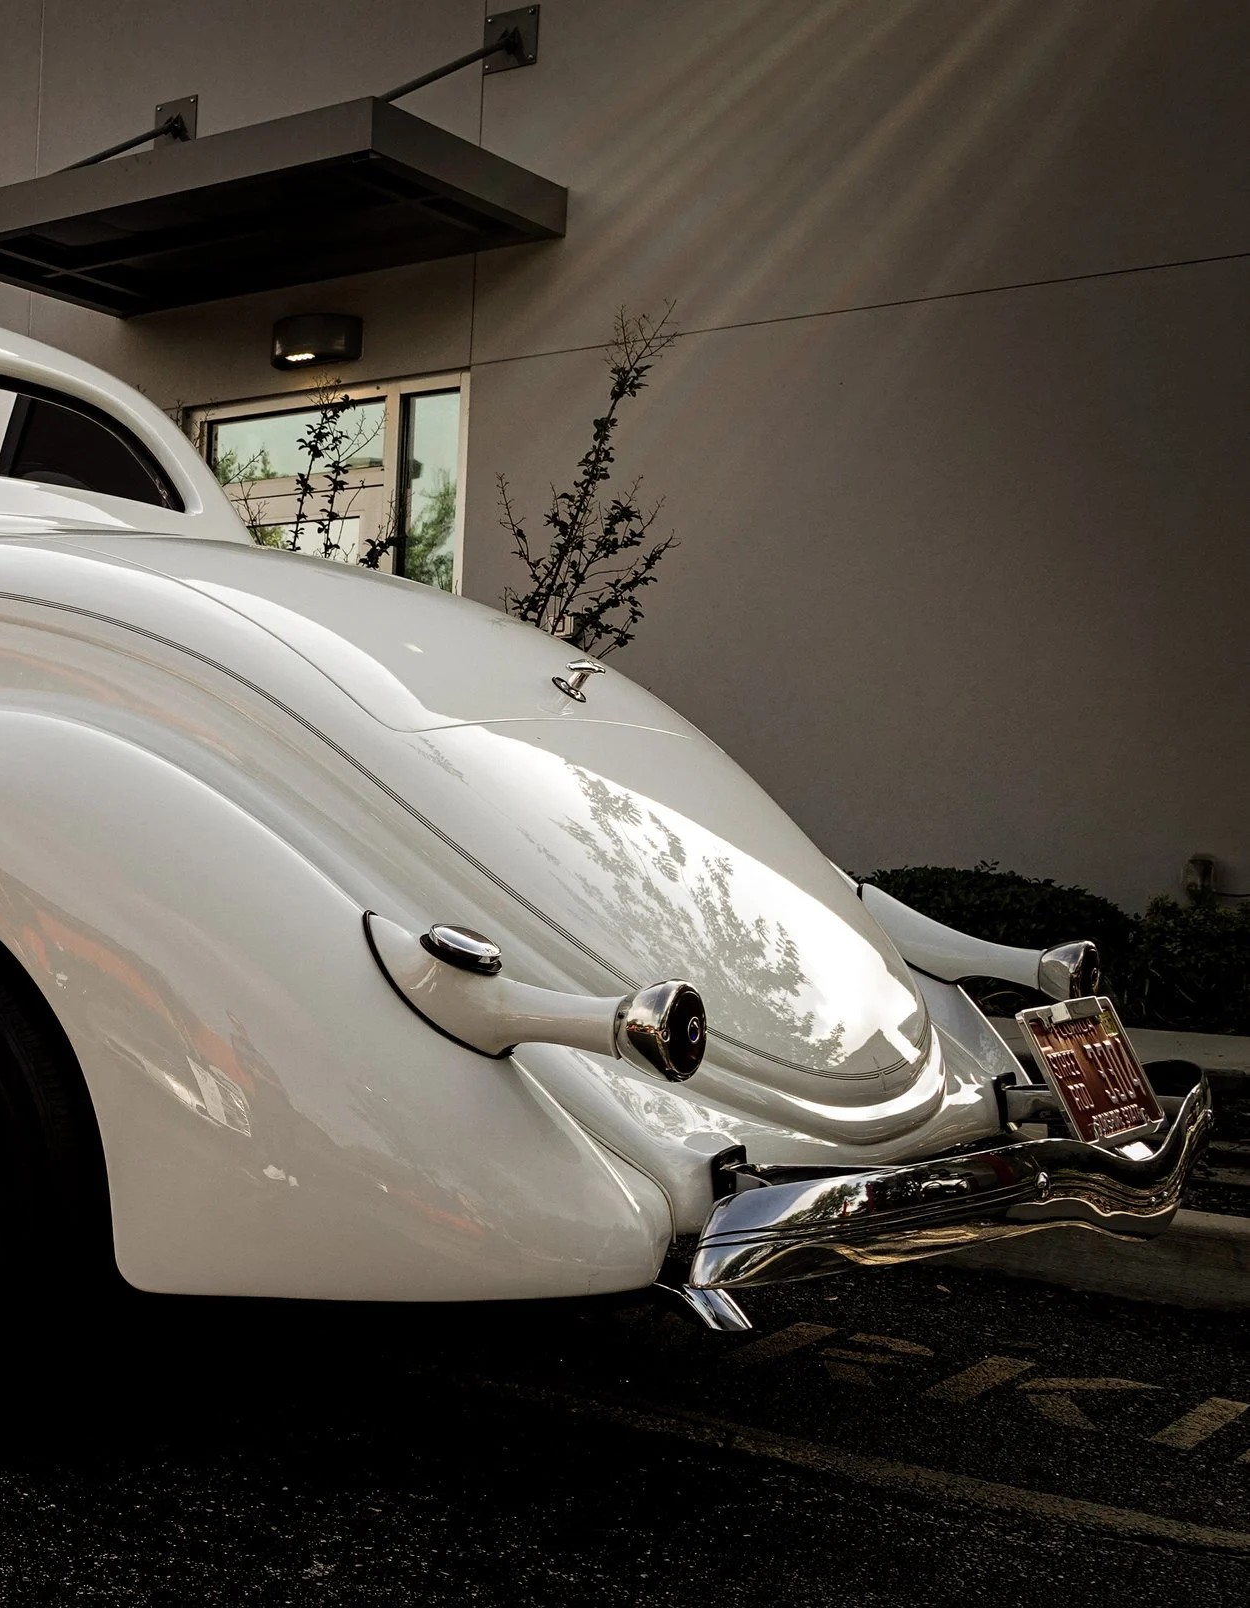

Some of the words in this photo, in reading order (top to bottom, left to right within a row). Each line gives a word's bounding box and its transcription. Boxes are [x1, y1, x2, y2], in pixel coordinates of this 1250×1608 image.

[1047, 1049, 1087, 1080] STREET
[1083, 1038, 1146, 1104] 3304
[1068, 1083, 1094, 1111] ROD
